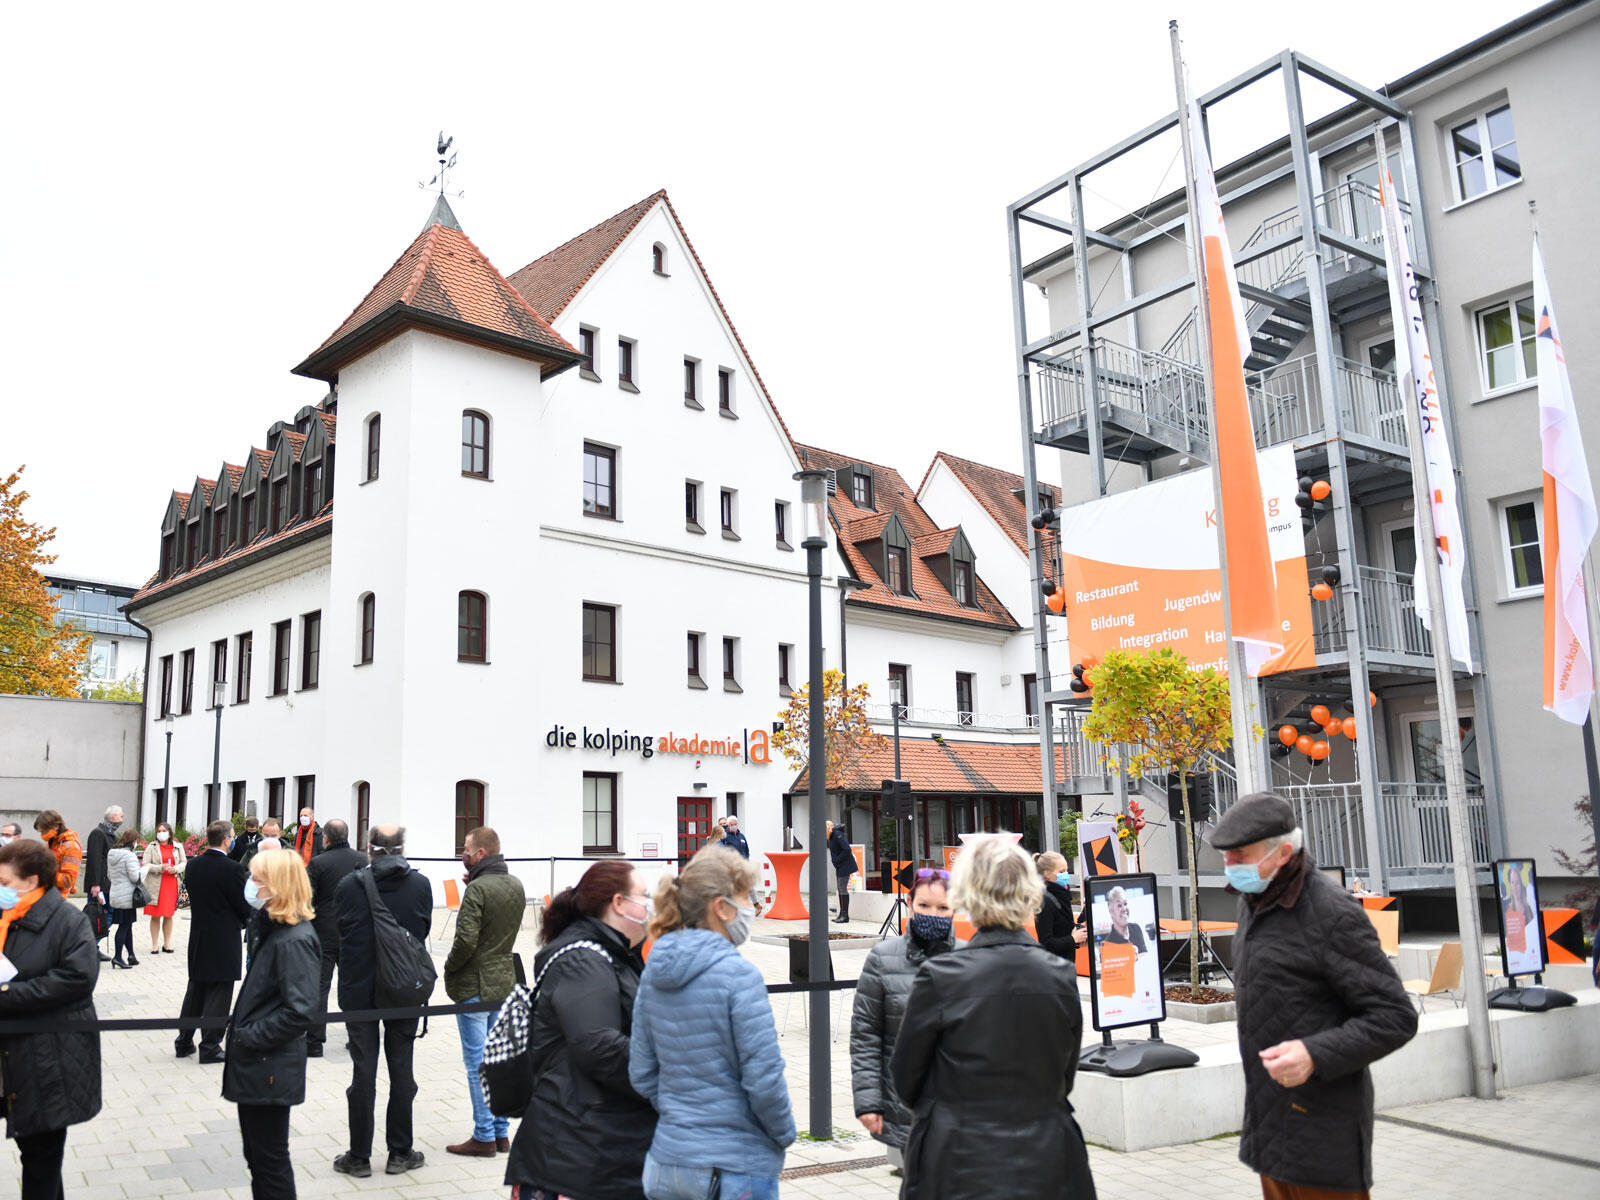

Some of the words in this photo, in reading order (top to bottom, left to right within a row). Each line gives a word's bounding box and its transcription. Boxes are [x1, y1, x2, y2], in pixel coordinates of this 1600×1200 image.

[1076, 580, 1139, 604] Restaurant
[1164, 589, 1222, 612] Jugendw
[1091, 614, 1135, 631] Bildung
[1120, 628, 1189, 649] Integration
[546, 724, 577, 748] die
[583, 726, 654, 758] kolping
[658, 731, 741, 756] akademie
